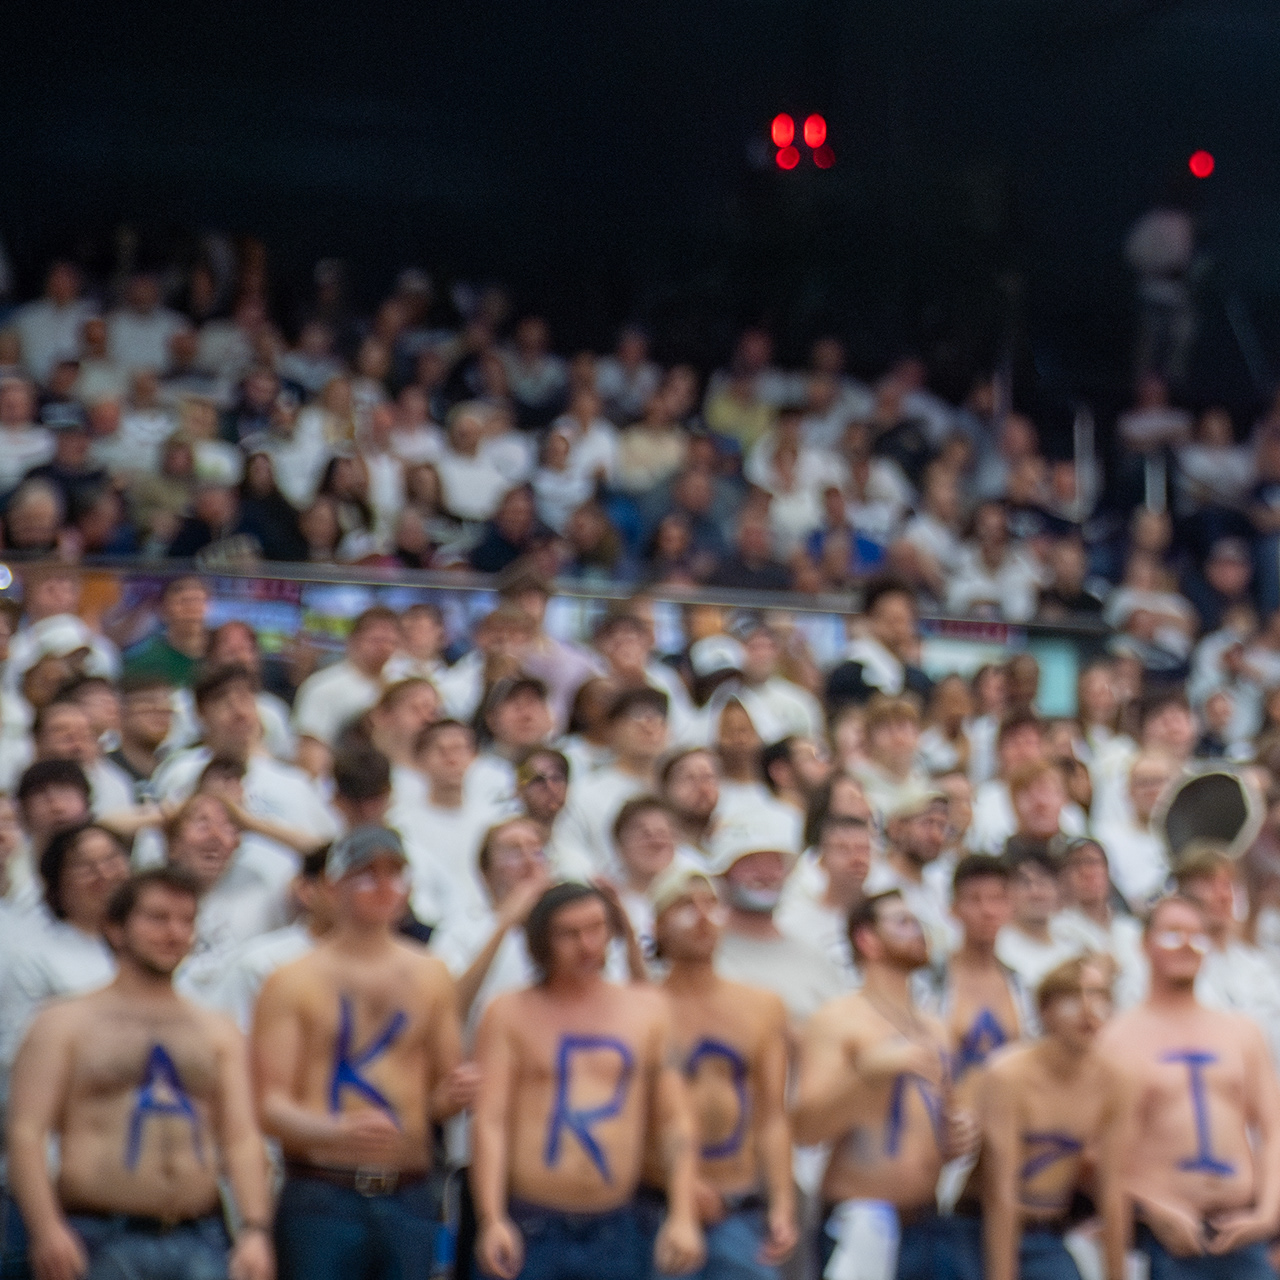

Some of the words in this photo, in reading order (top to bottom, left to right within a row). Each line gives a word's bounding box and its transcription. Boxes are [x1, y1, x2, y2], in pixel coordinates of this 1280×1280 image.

[125, 1042, 208, 1172] A
[327, 994, 409, 1130] K
[544, 1033, 637, 1187] R
